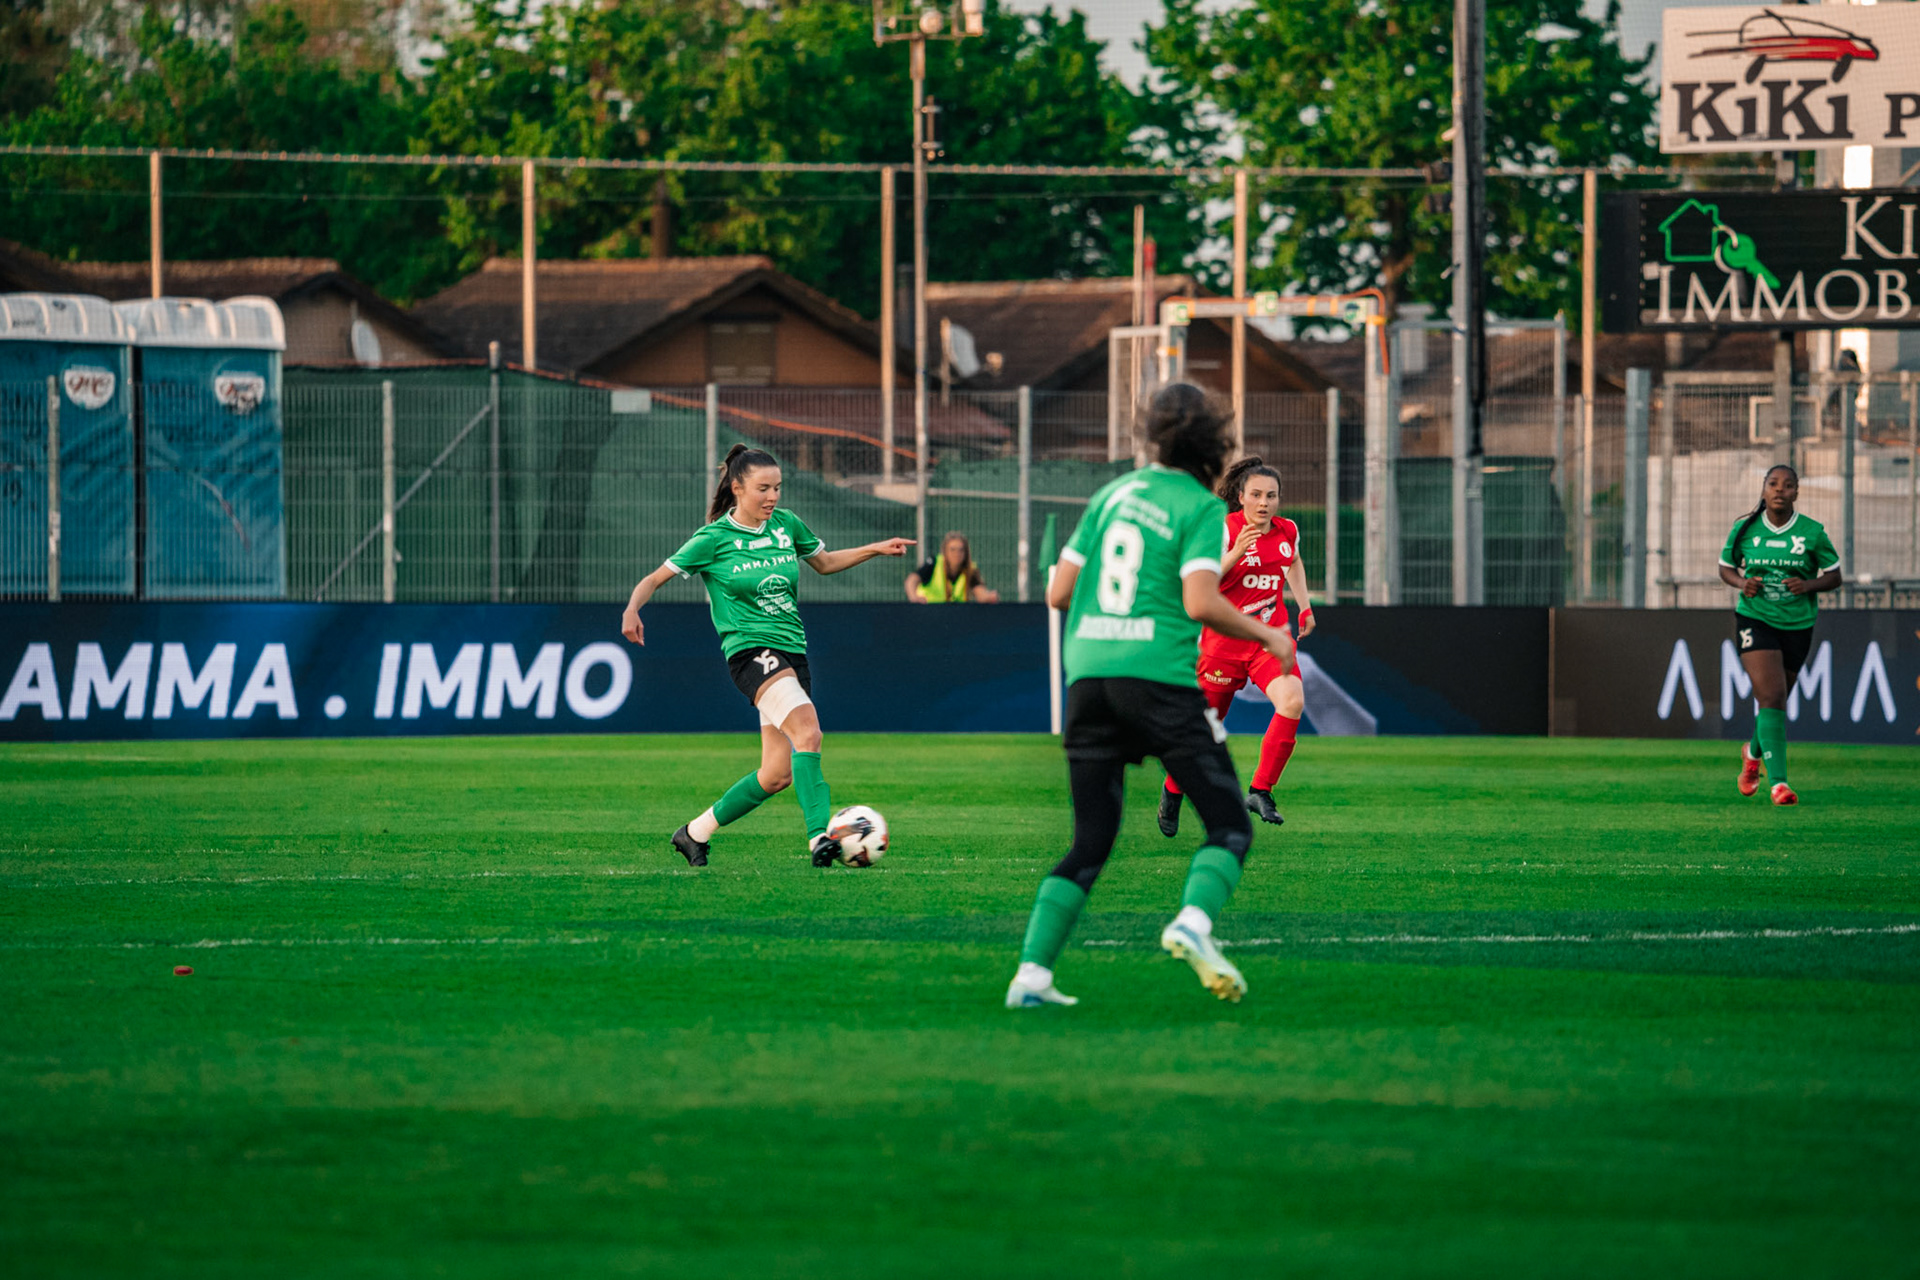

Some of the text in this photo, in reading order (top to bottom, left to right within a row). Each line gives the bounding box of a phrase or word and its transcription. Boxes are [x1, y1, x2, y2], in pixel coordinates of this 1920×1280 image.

[1655, 265, 1920, 323] IMMOB
[1098, 519, 1145, 616] 8
[1242, 574, 1281, 590] OBT
[0, 643, 299, 719] AMMA
[373, 642, 634, 719] IMMO
[1657, 637, 1897, 723] AMMA
